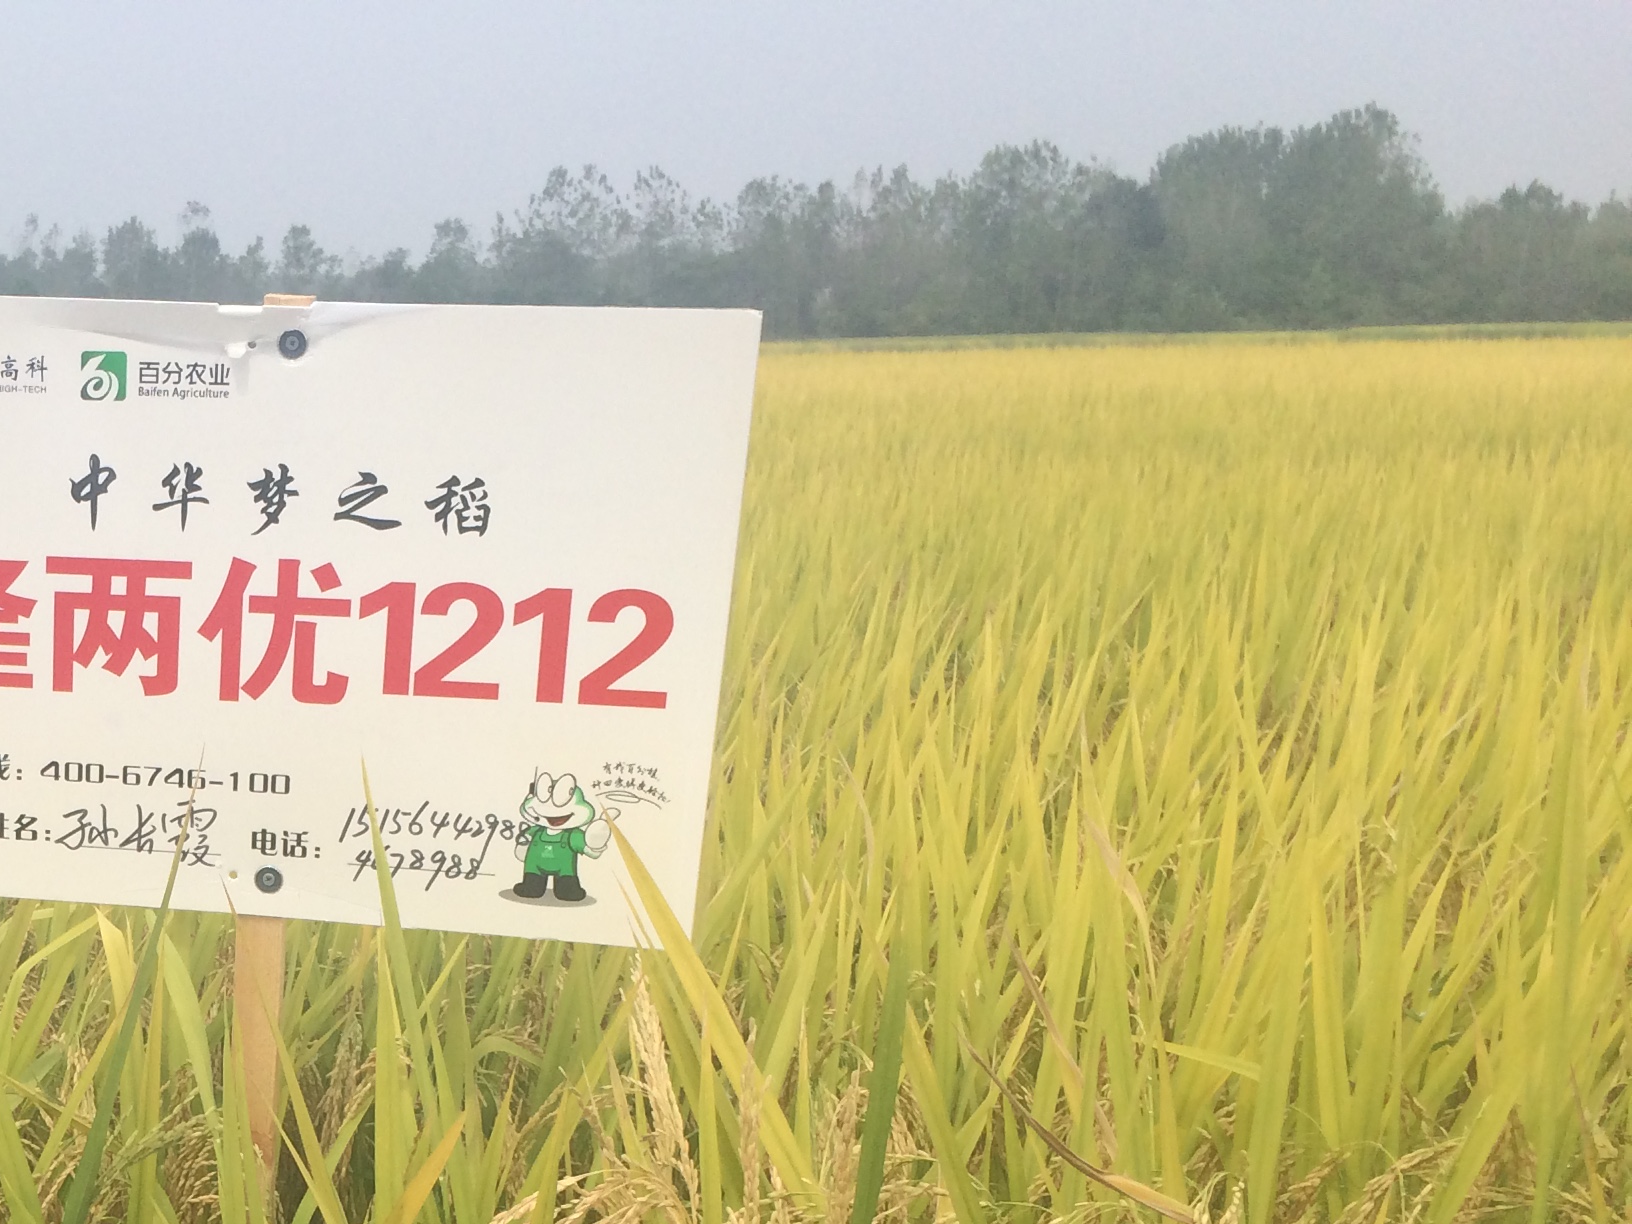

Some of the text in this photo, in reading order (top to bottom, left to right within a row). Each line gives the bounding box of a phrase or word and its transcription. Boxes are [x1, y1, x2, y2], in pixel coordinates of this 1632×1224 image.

[138, 361, 231, 386] 百分农业
[138, 386, 230, 400] Baifen Agriculture
[68, 454, 493, 538] 中华梦之稻
[250, 828, 322, 860] 电话：
